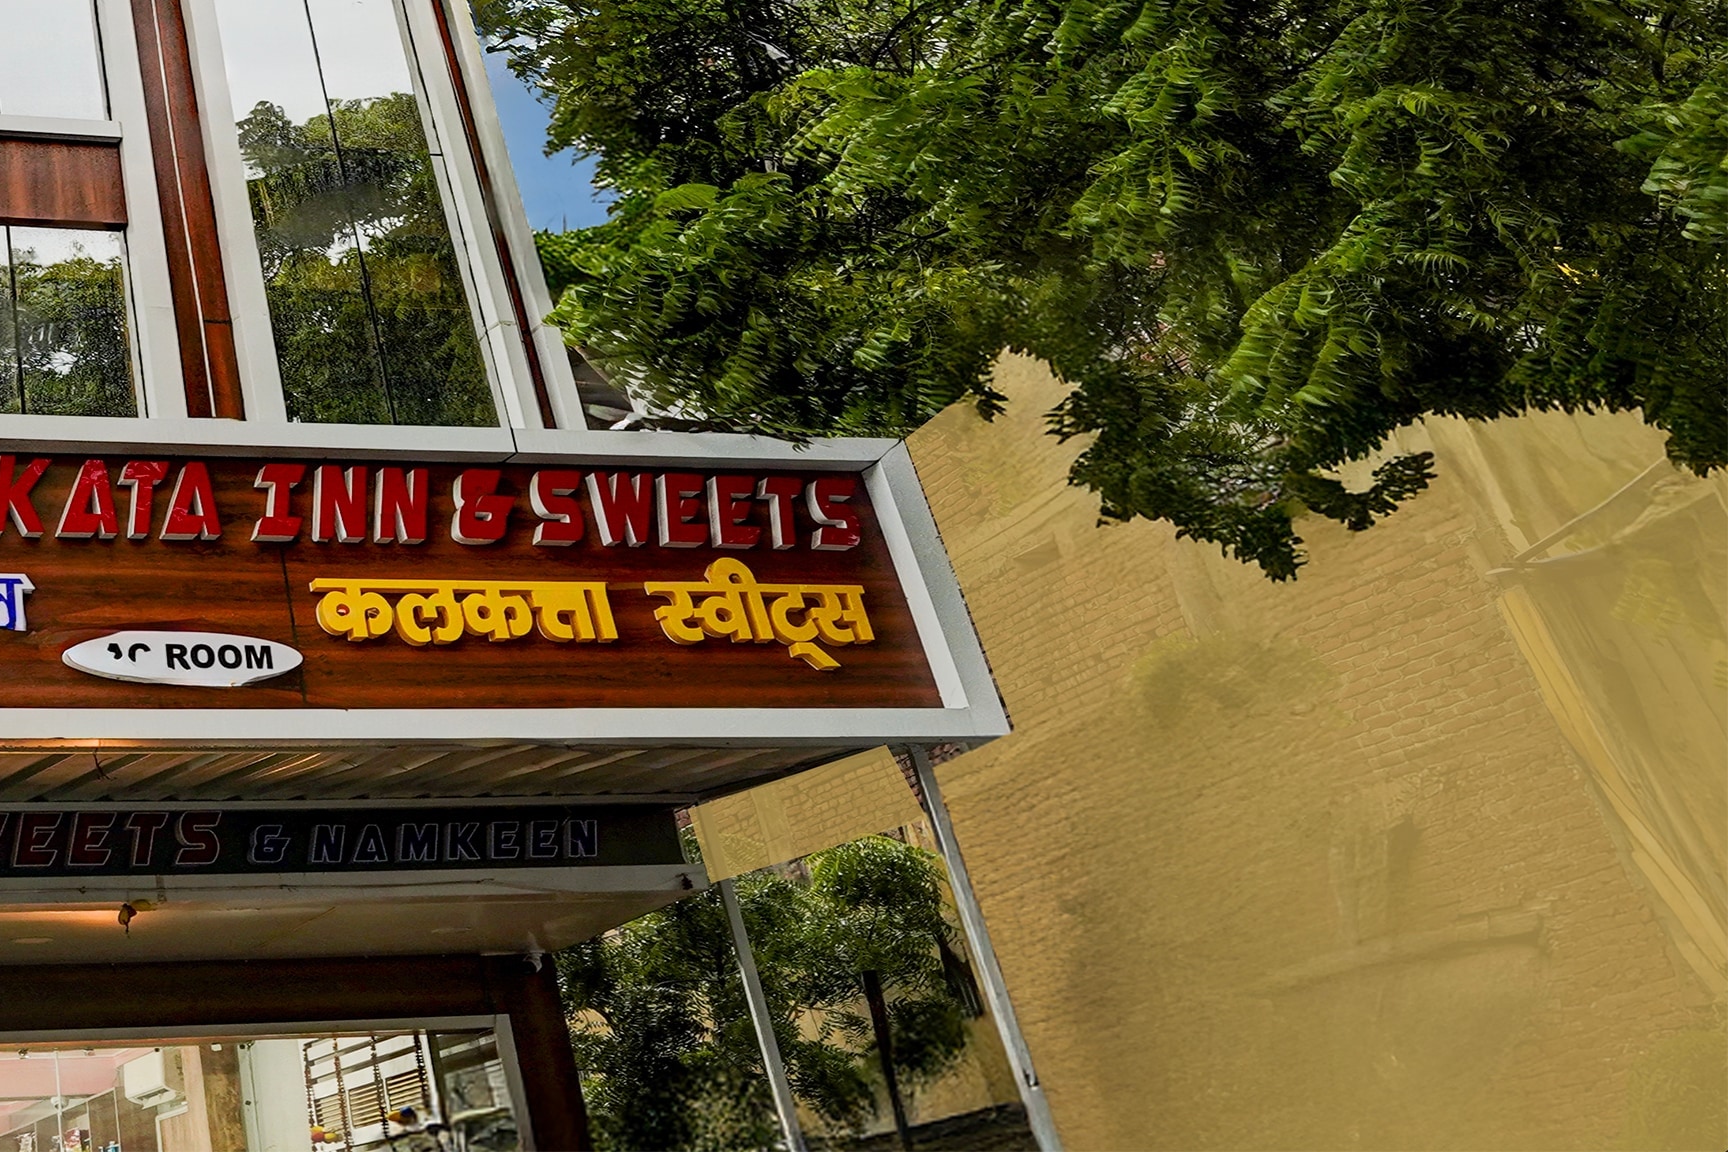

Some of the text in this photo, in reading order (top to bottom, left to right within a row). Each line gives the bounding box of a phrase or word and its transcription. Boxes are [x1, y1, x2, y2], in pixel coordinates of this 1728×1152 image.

[250, 463, 429, 545] INN
[450, 469, 517, 545] &
[529, 470, 862, 550] SWEETS
[309, 557, 875, 672] कलकत्ता स्वीट्स
[165, 643, 273, 670] ROOM
[249, 824, 292, 864] &
[309, 819, 598, 863] NAMKEEN
